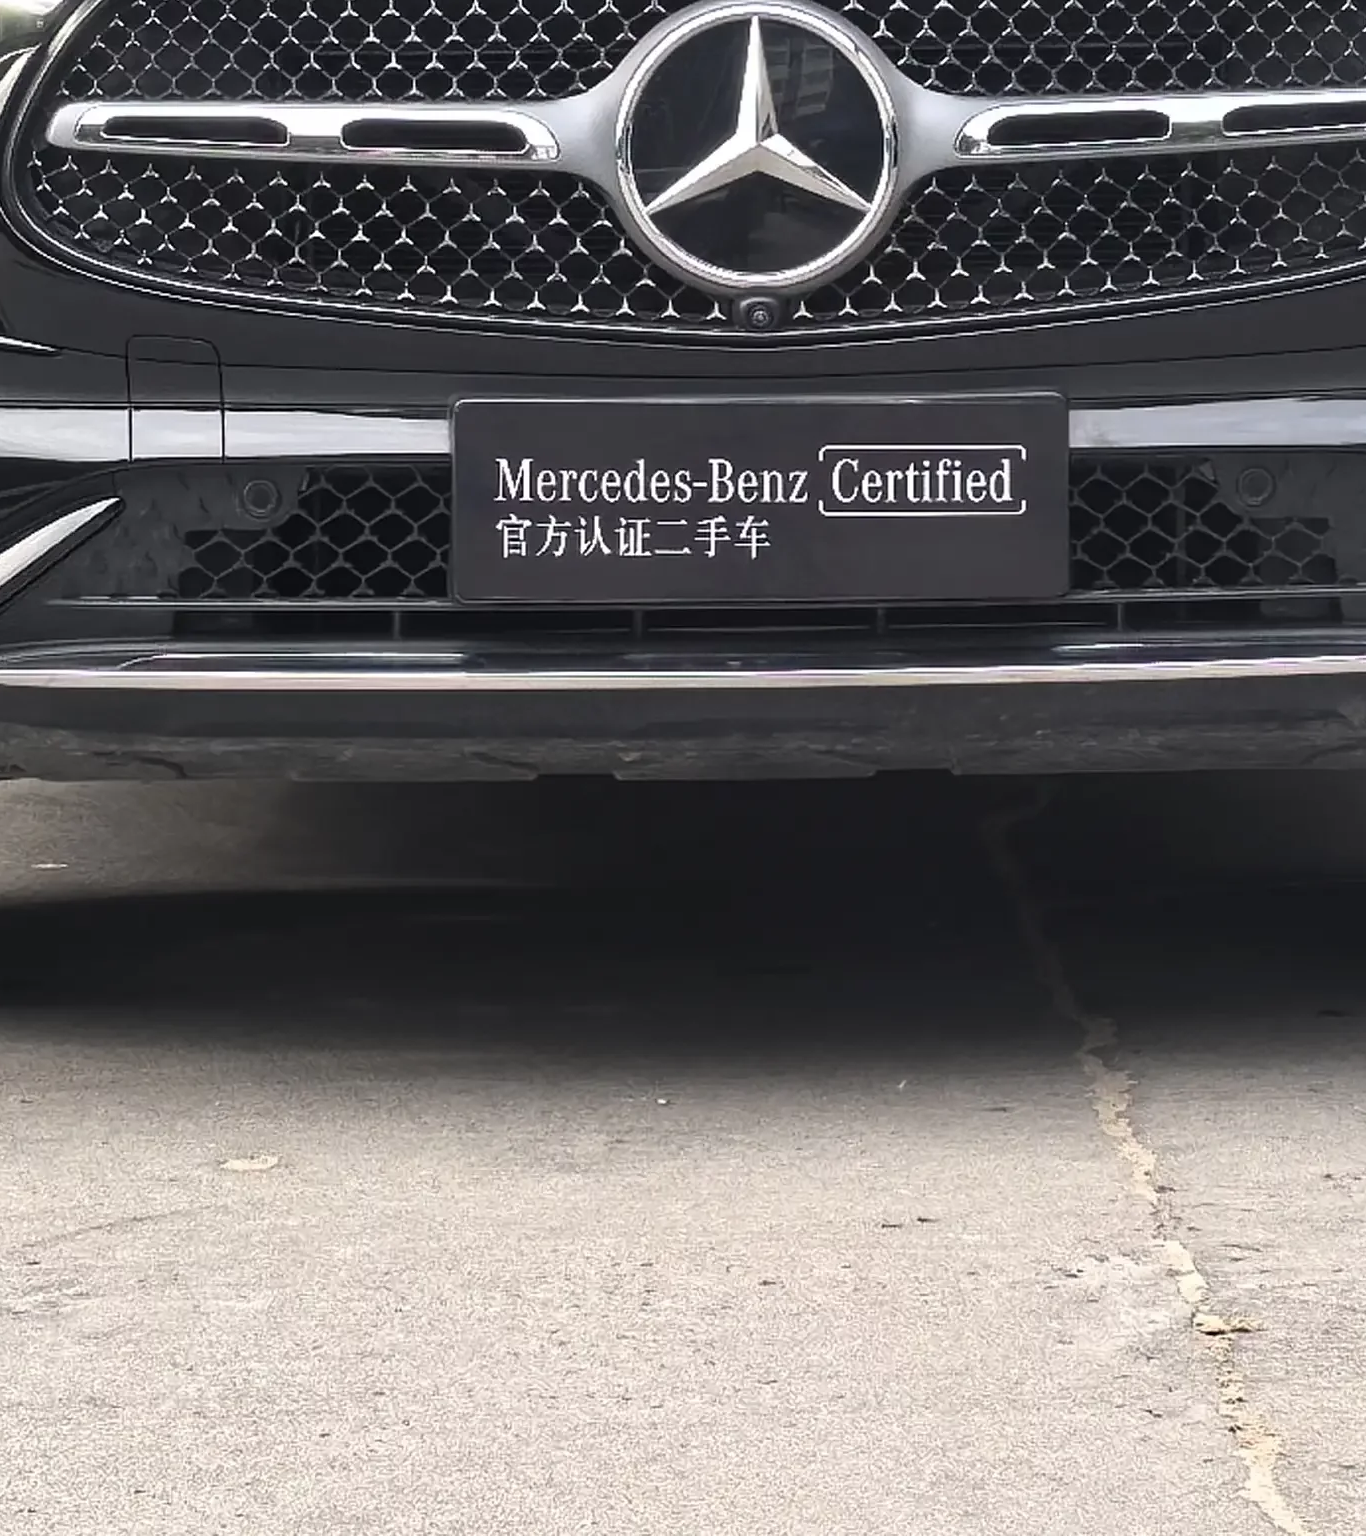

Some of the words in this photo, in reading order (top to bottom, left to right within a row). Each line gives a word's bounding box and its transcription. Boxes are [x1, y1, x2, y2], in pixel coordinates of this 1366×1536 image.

[494, 459, 807, 503] Mercedes-Benz
[832, 459, 1013, 503] Certified
[496, 514, 770, 559] 官方认证二手车
